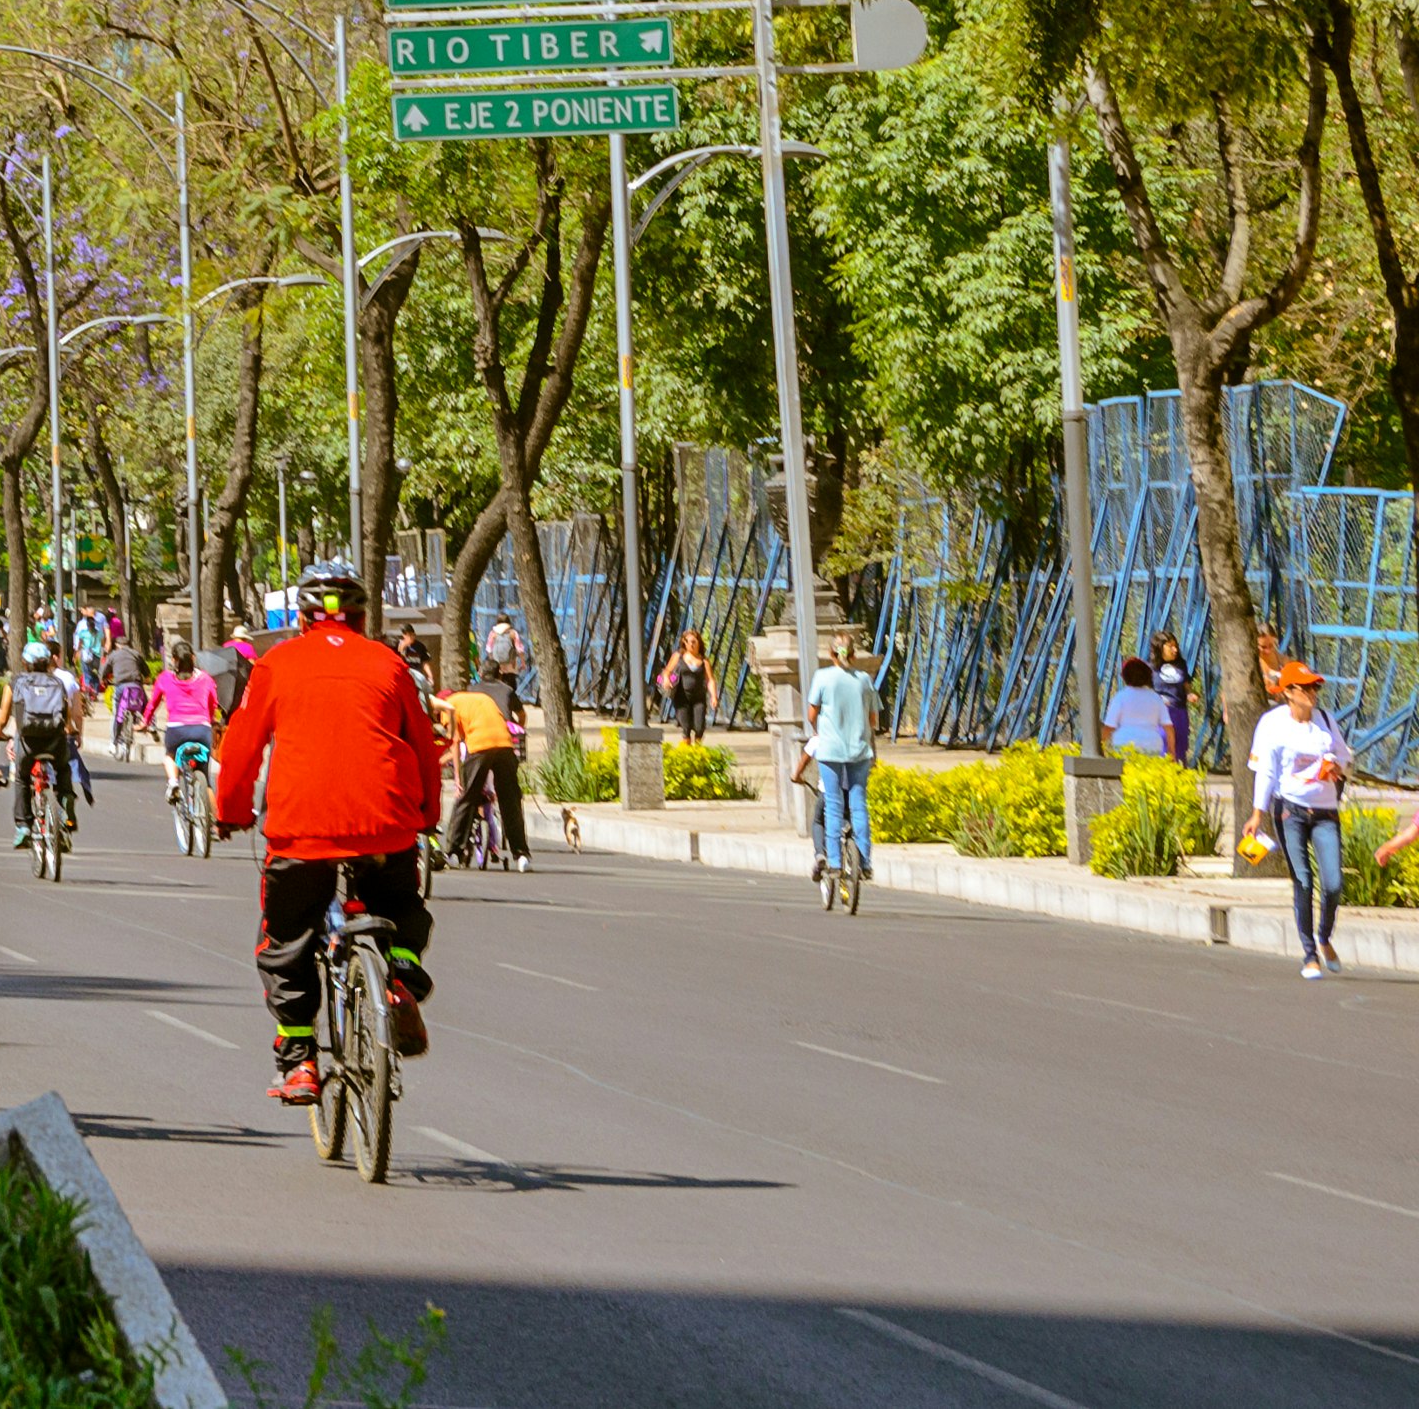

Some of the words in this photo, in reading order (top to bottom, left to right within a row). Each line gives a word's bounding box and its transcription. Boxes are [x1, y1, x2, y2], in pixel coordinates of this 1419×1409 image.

[396, 36, 470, 65] RIO
[488, 29, 620, 62] TIBER
[444, 101, 495, 130] EJE
[504, 100, 523, 128] 2
[532, 94, 671, 128] PONIENTE
